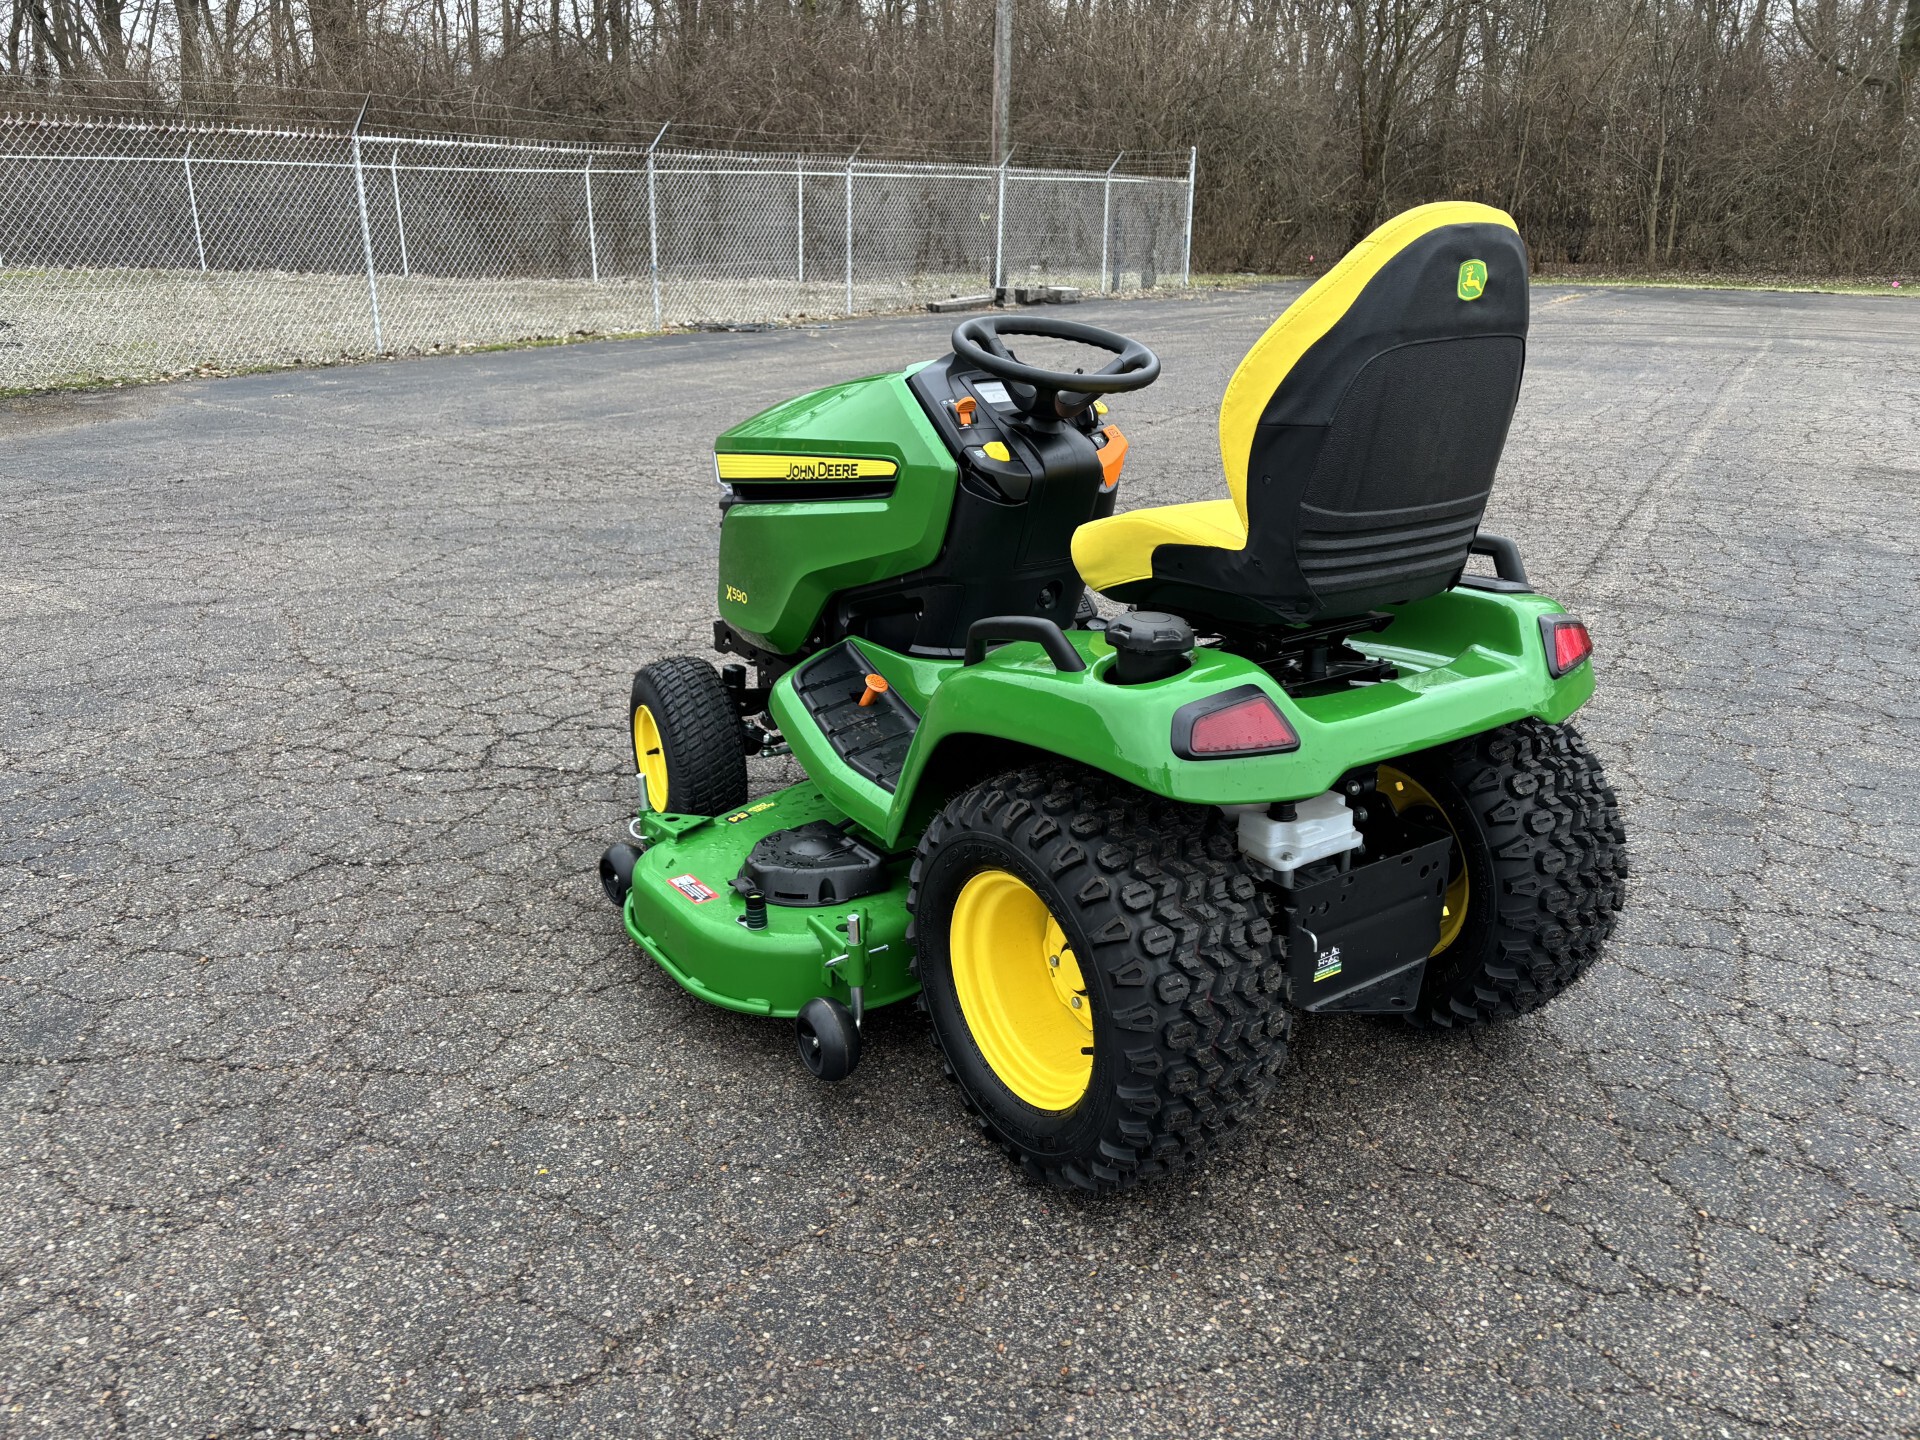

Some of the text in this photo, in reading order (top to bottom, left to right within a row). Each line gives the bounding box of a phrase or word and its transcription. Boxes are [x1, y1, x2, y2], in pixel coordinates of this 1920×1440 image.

[786, 461, 859, 479] JOHN DEERE
[725, 583, 748, 605] X590
